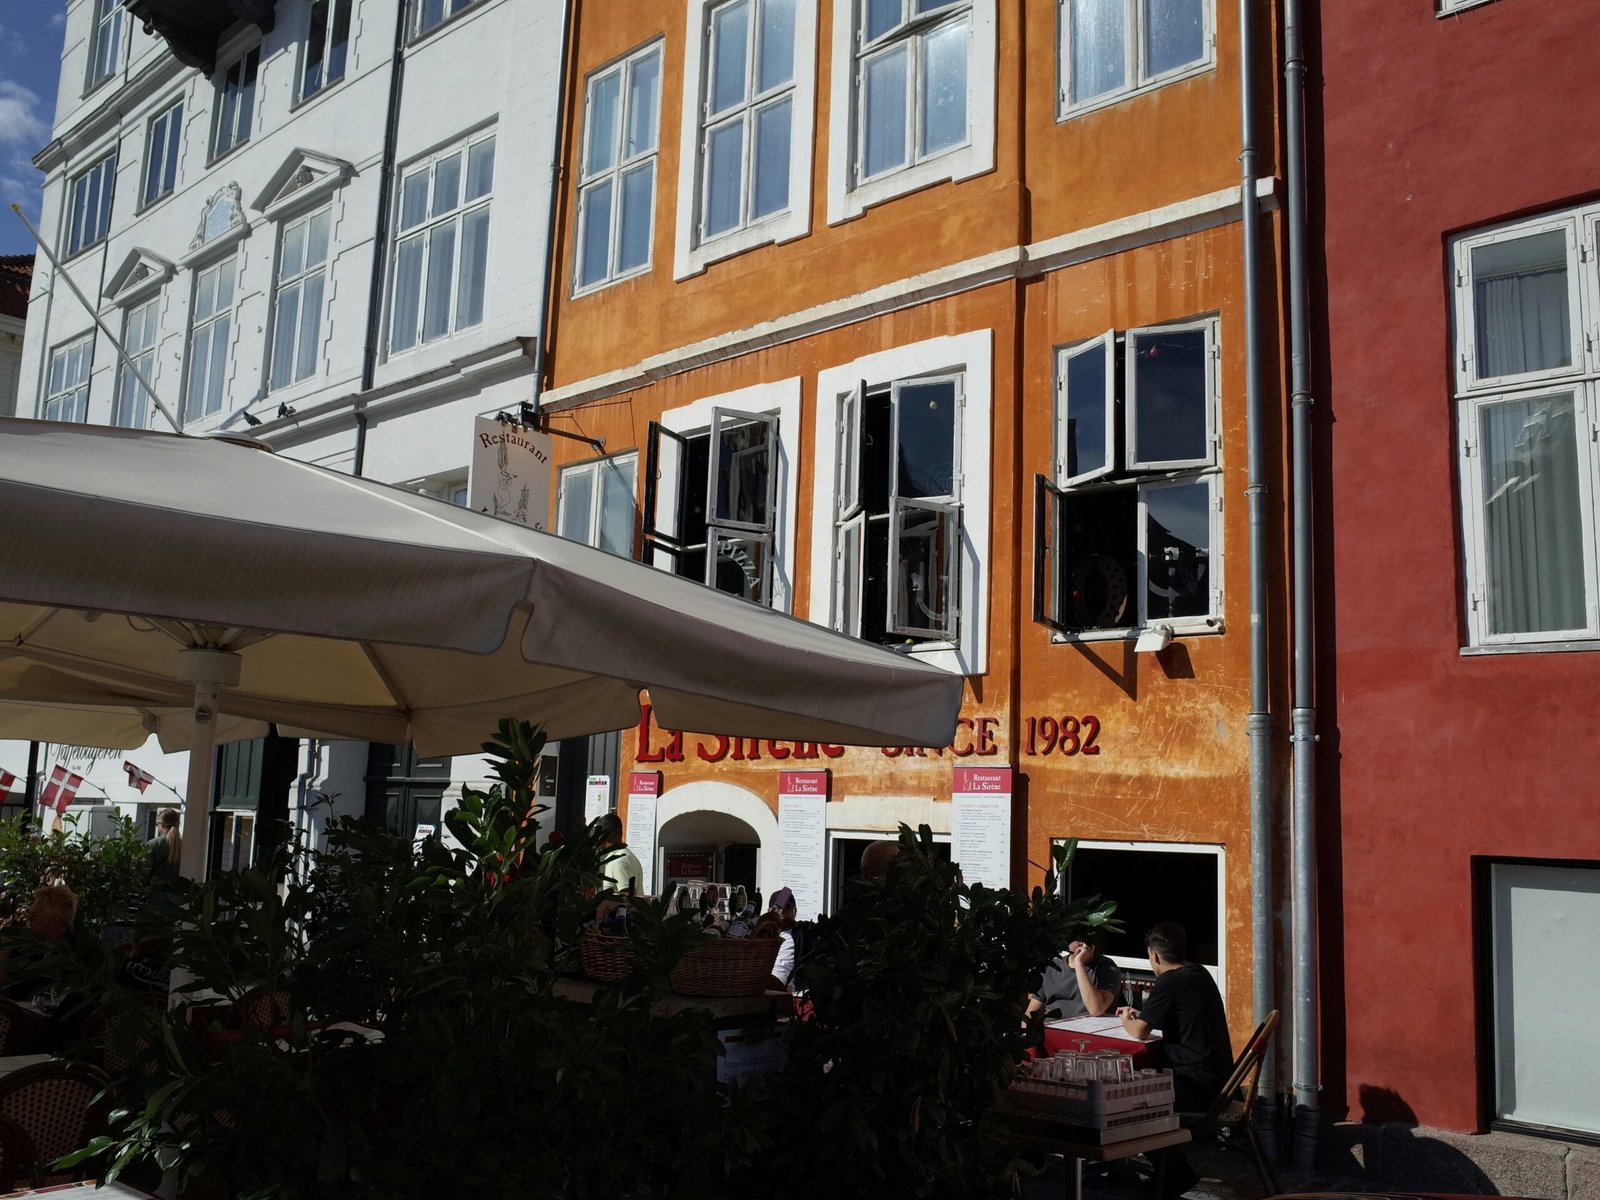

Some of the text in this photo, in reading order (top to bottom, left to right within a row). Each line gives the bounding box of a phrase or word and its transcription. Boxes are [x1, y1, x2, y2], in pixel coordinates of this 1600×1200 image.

[479, 432, 549, 464] Restaurant
[719, 540, 760, 589] PIZZA
[635, 704, 685, 763] La
[1025, 715, 1101, 756] 1982
[795, 784, 801, 792] La
[973, 782, 980, 790] La
